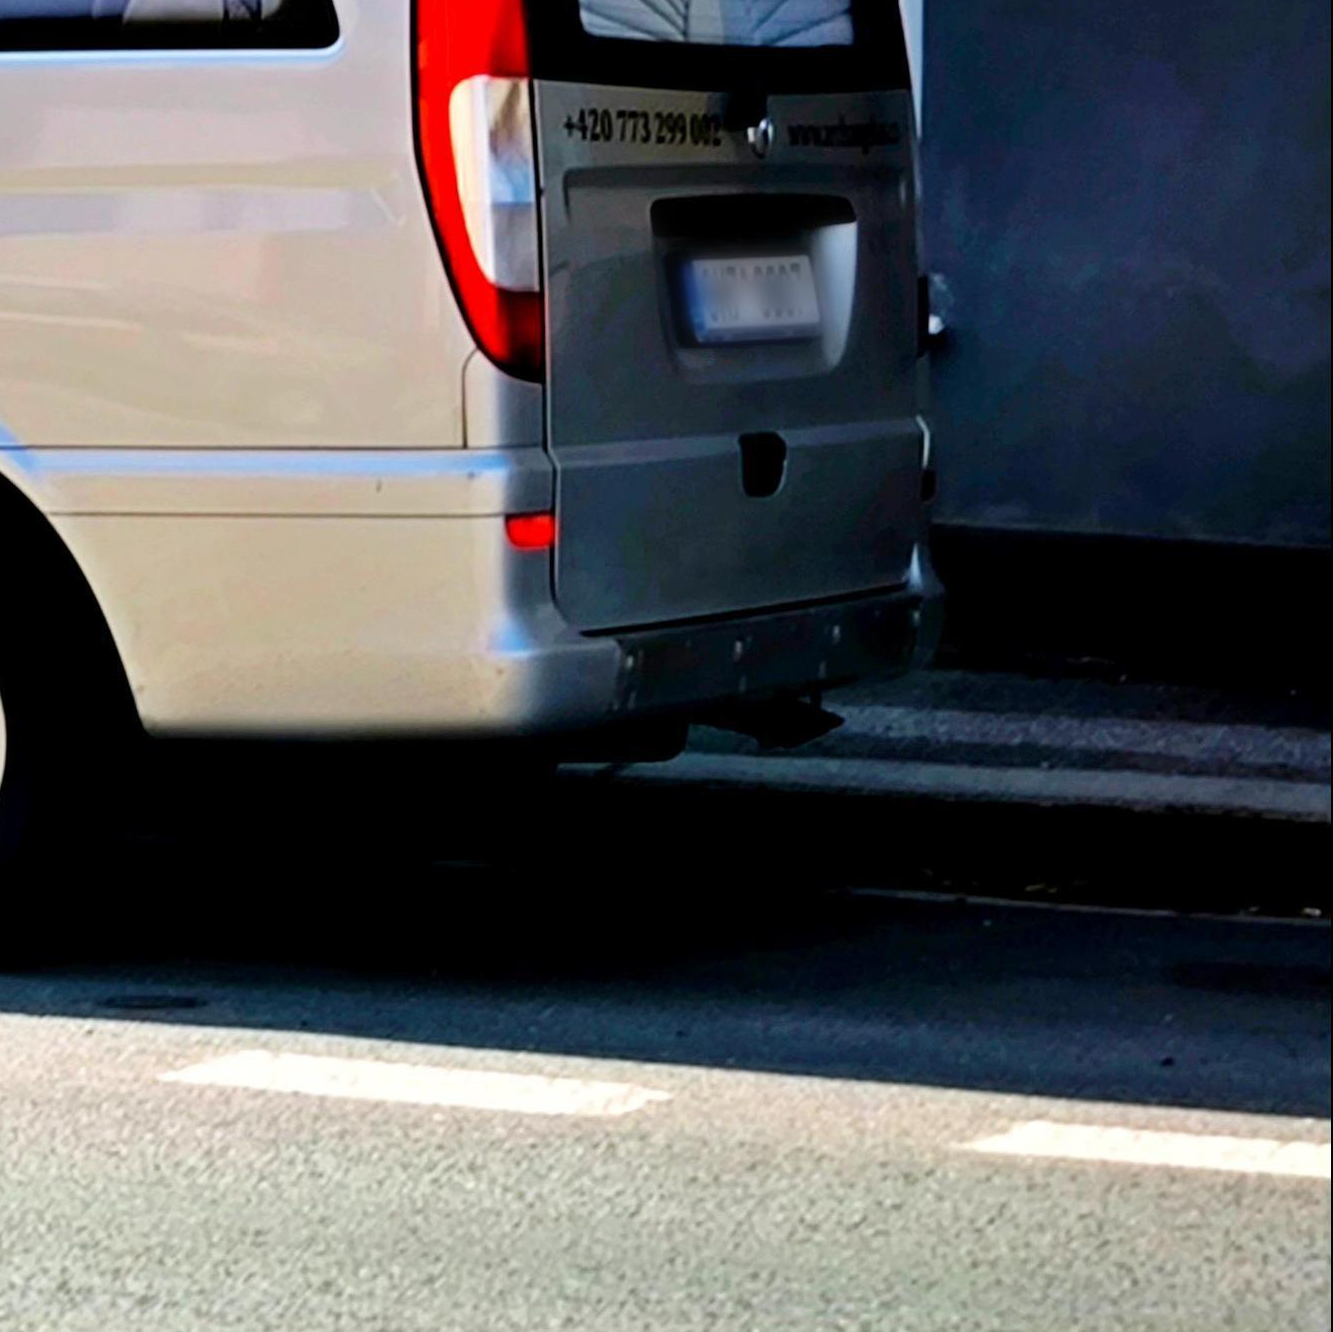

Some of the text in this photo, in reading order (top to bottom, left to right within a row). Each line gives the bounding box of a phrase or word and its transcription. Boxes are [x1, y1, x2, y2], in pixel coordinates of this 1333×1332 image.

[563, 108, 613, 142] +420
[616, 110, 652, 144] 773
[655, 112, 687, 145] 299
